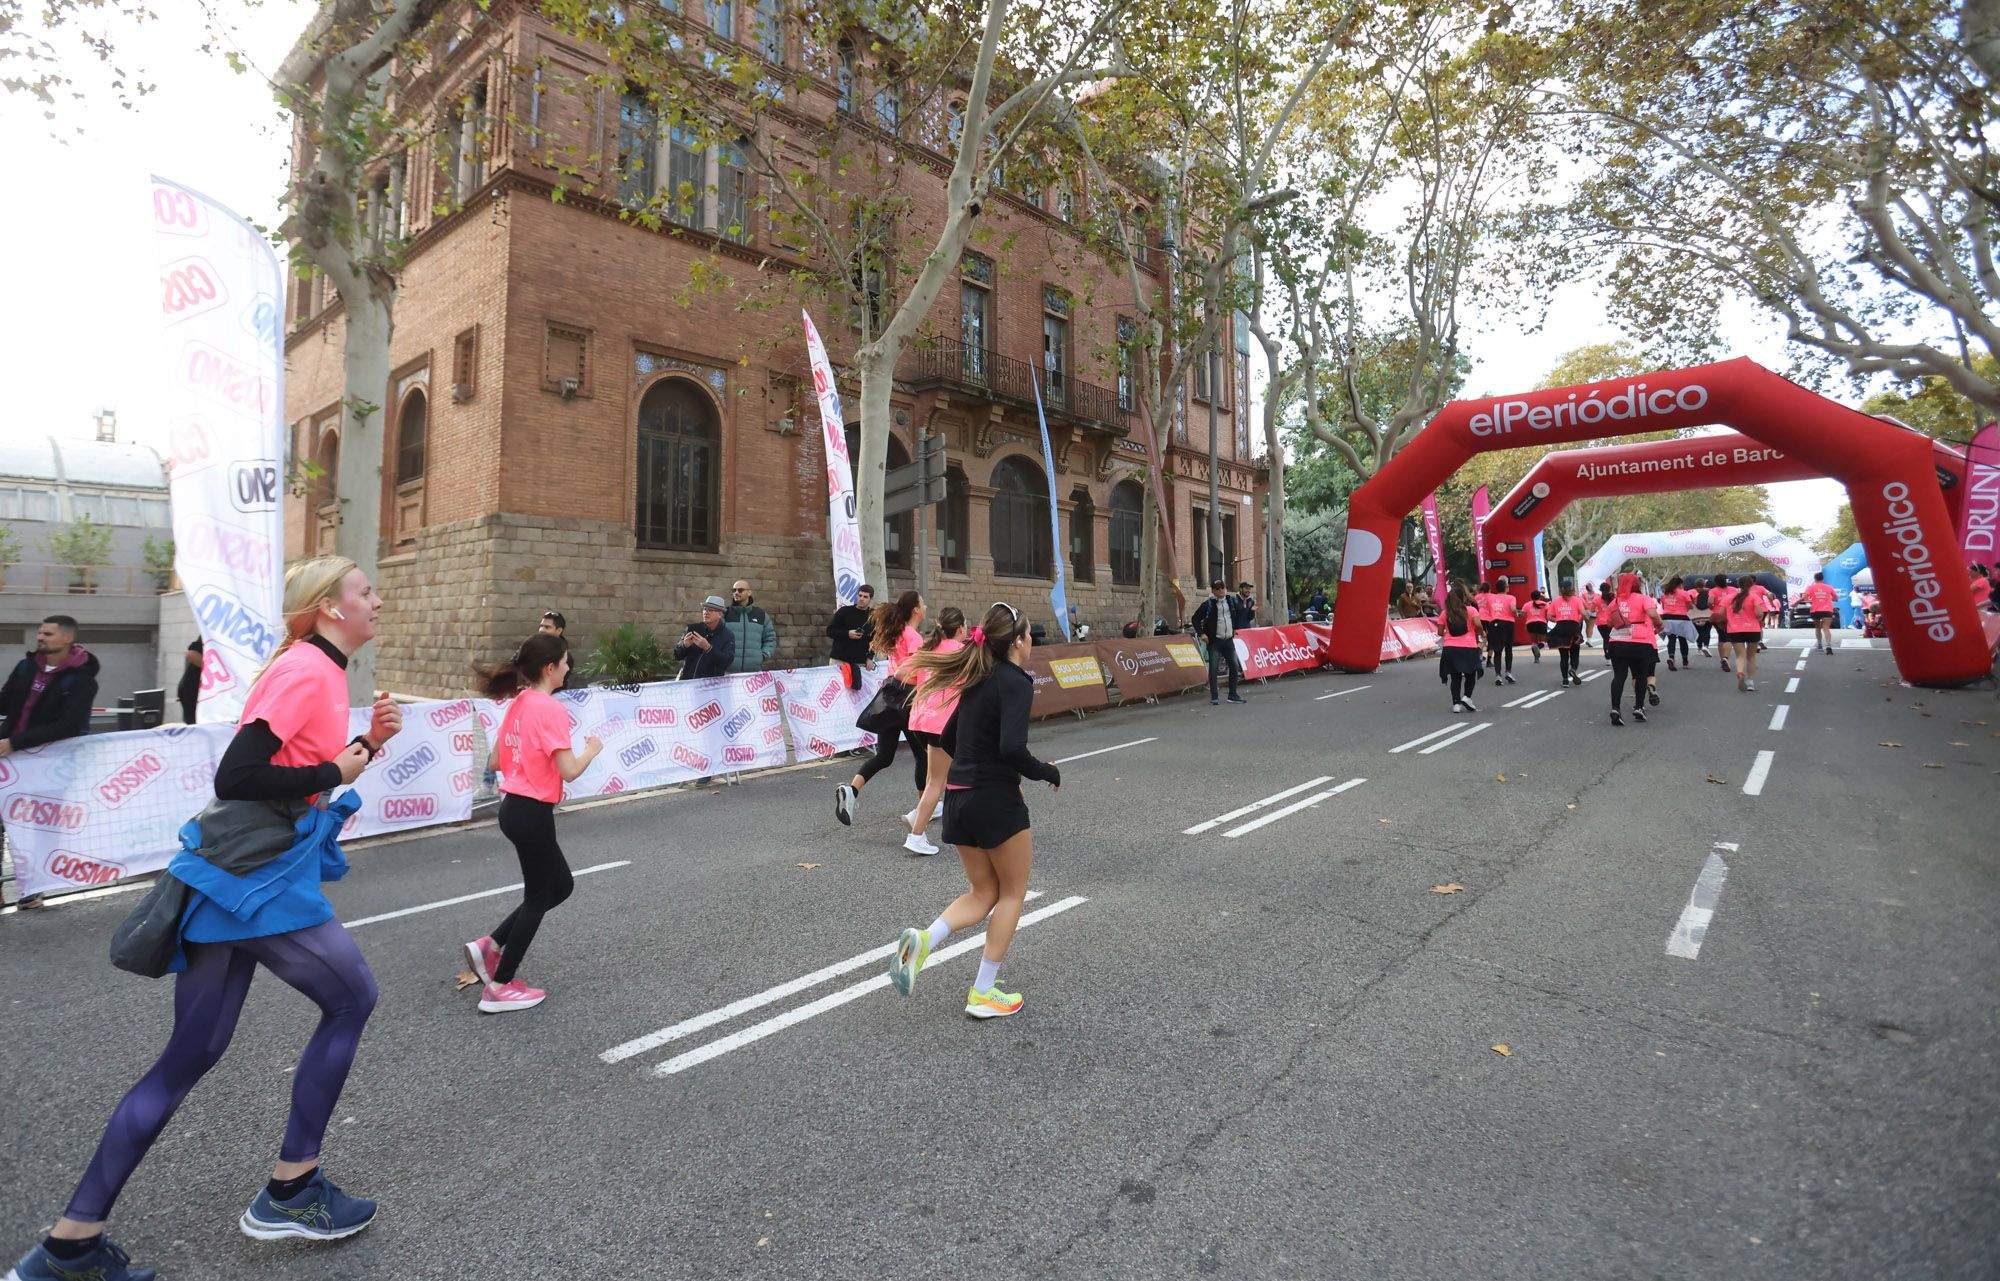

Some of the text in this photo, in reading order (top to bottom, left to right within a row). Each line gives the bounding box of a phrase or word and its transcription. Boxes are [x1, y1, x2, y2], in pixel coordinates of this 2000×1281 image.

[1469, 383, 1708, 437] elPeriódico
[1576, 454, 1694, 478] Ajuntament
[1701, 450, 1727, 467] de
[1624, 545, 1648, 555] COSMO
[1729, 532, 1755, 547] COSMO
[1882, 481, 1954, 642] elPeriódico
[1254, 642, 1315, 669] elPeriódico
[745, 671, 773, 693] COSMO
[819, 679, 842, 710] COSMO
[430, 699, 471, 727] COSMO
[638, 709, 675, 724] COSMO
[688, 702, 721, 729] COSMO
[723, 707, 752, 739] COSMO
[789, 702, 816, 723] COSMO
[620, 738, 655, 767] COSMO
[673, 746, 709, 772] COSMO
[725, 747, 755, 762] COSMO
[809, 737, 836, 757] COSMO
[100, 754, 161, 803] COSMO
[388, 746, 435, 785] COSMO
[9, 797, 83, 829] COSMO
[384, 797, 434, 818] COSMO
[51, 854, 120, 884] COSMO
